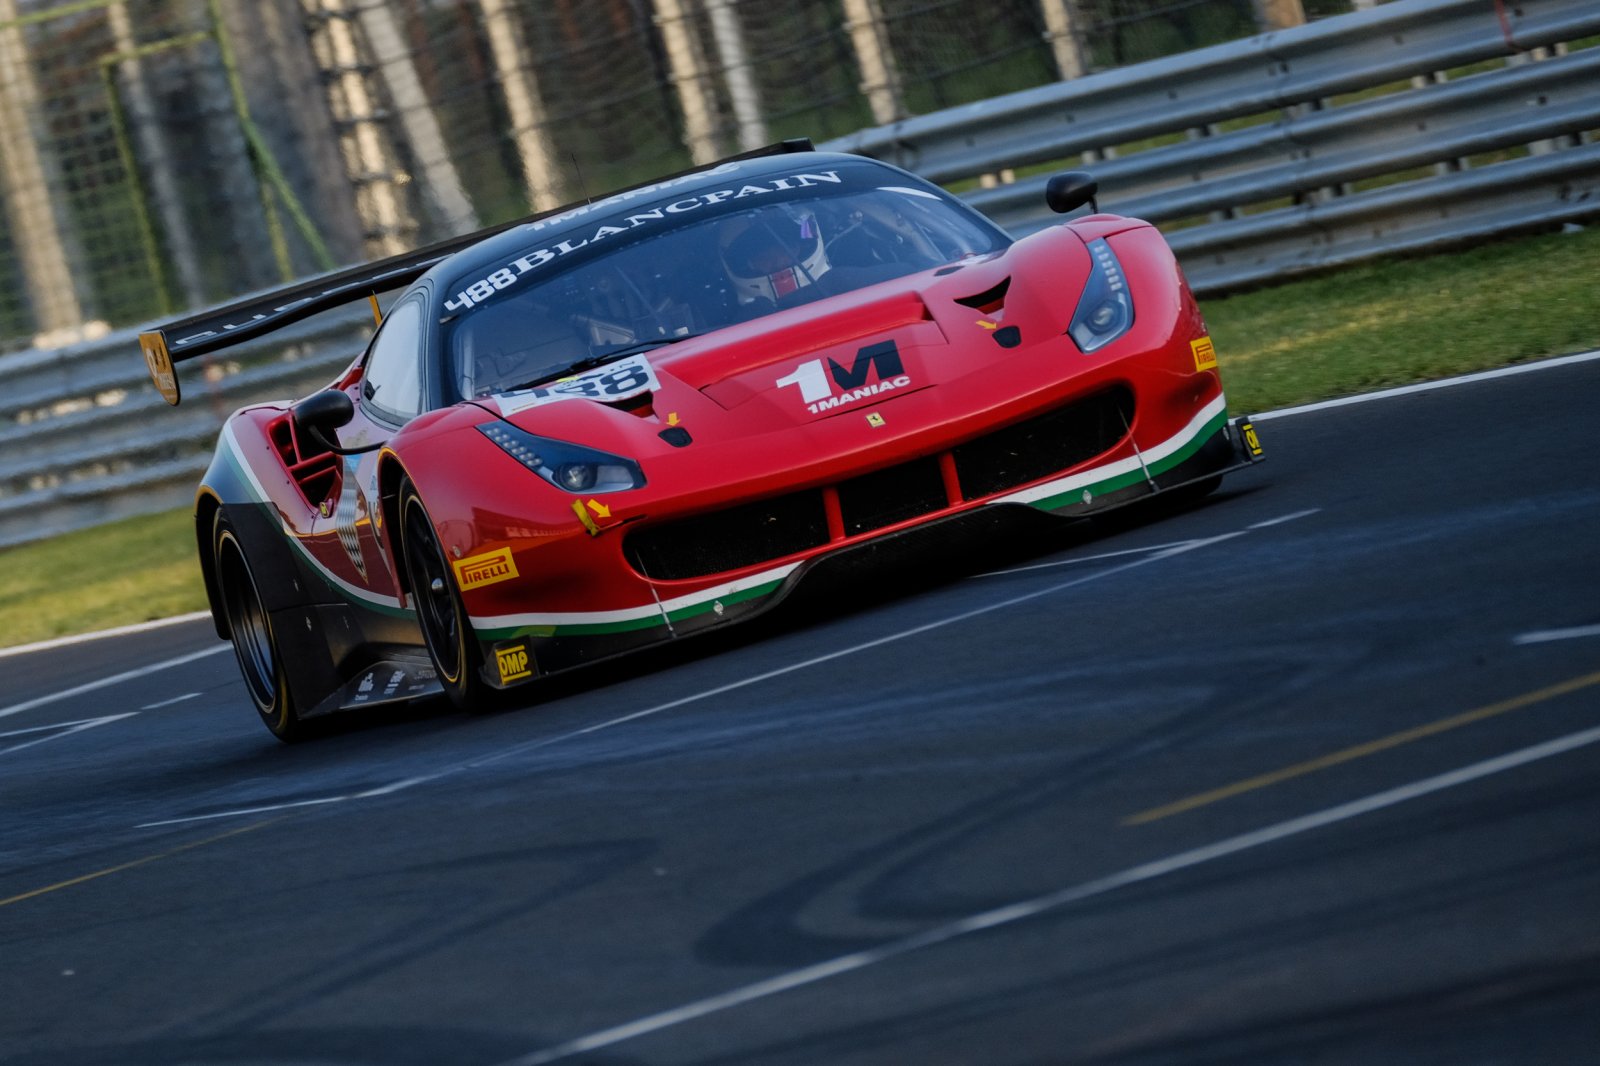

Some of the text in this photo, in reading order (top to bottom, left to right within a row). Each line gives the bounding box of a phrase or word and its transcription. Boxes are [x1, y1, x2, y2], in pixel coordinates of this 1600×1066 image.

[443, 267, 518, 312] 488
[510, 171, 843, 276] BLANCPAIN
[807, 376, 911, 415] 1MANIAC
[459, 555, 511, 585] PIRELLI
[499, 650, 528, 677] OMP
